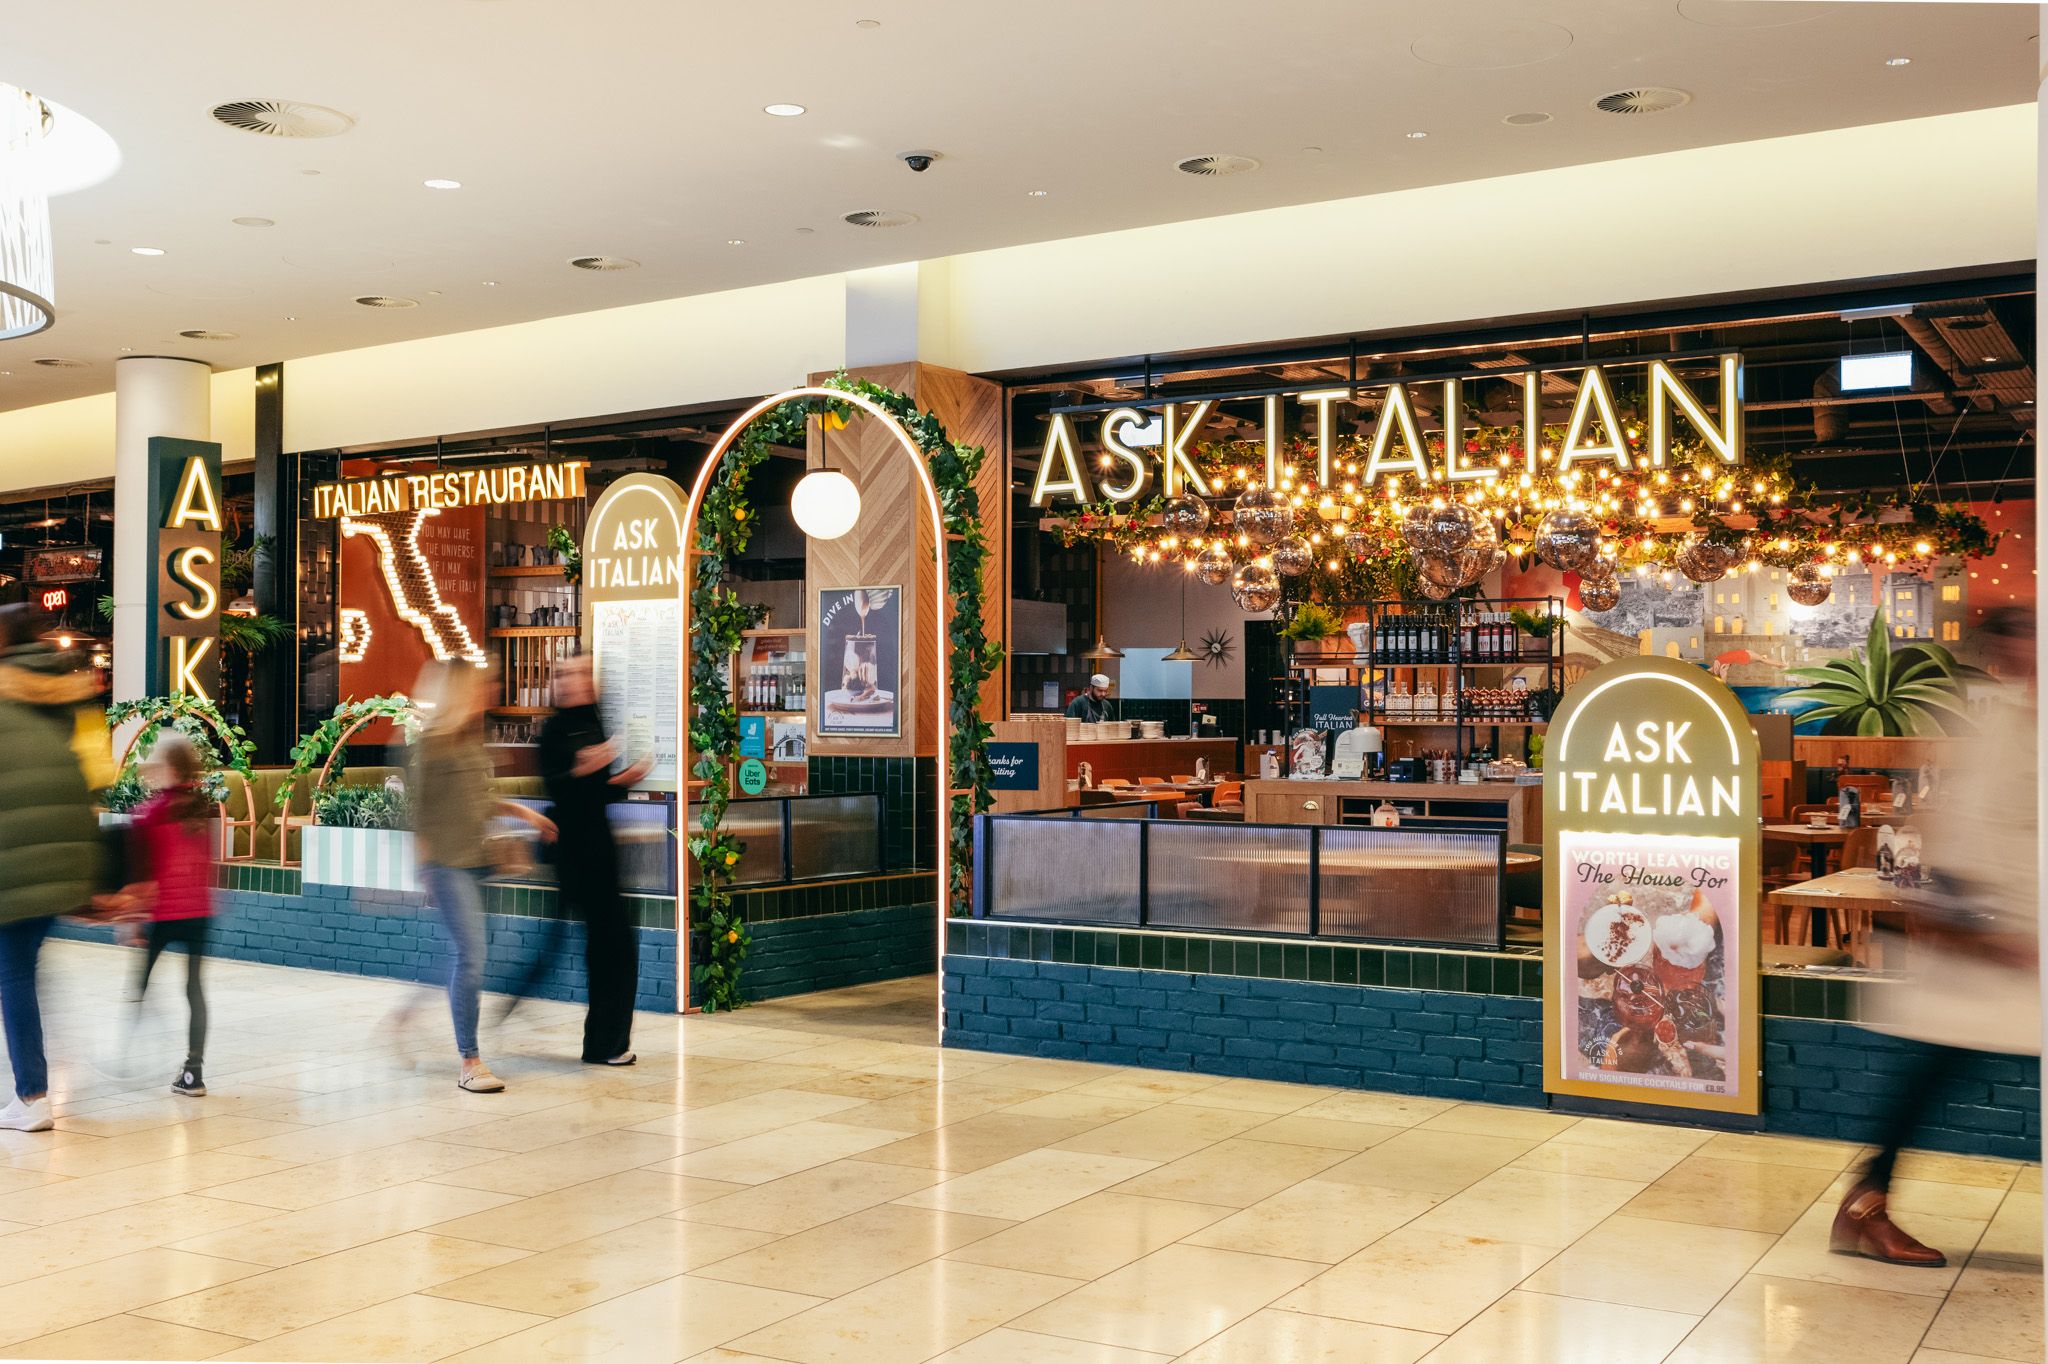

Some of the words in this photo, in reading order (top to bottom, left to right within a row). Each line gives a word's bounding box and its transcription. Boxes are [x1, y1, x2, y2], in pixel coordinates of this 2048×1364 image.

[1032, 400, 1210, 507] ASK
[1265, 353, 1743, 491] ITALIAN
[314, 478, 401, 519] ITALIAN
[412, 462, 582, 510] RESTAURANT
[437, 526, 451, 539] MAY
[454, 528, 471, 541] HAVE
[613, 518, 660, 551] ASK
[426, 543, 439, 556] THE
[441, 544, 475, 559] UNIVERSE
[433, 561, 440, 573] IF
[447, 562, 461, 574] MAY
[590, 554, 681, 588] ITALIAN
[166, 456, 223, 706] ASK
[439, 578, 457, 592] HAVE
[459, 580, 477, 593] ITALY
[43, 589, 67, 611] open
[822, 601, 842, 627] DIVE
[842, 593, 855, 605] IN
[1315, 721, 1353, 729] ITALIAN
[1328, 713, 1353, 721] Hearted
[1603, 721, 1693, 764] ASK
[1010, 755, 1024, 767] for
[744, 769, 761, 778] Uber
[744, 777, 761, 786] Eats
[1558, 771, 1741, 817] ITALIAN
[1572, 850, 1640, 867] WORTH
[1647, 852, 1731, 870] LEAVING
[1577, 862, 1615, 884] The
[1621, 864, 1686, 888] House
[1690, 867, 1729, 889] For
[1589, 1056, 1618, 1066] ITALIAN
[1596, 1050, 1610, 1058] ASK
[1578, 1071, 1598, 1081] NEW
[1598, 1073, 1644, 1085] SIGNATURE
[1644, 1077, 1688, 1090] COCKTAILS
[1688, 1082, 1705, 1092] FOR
